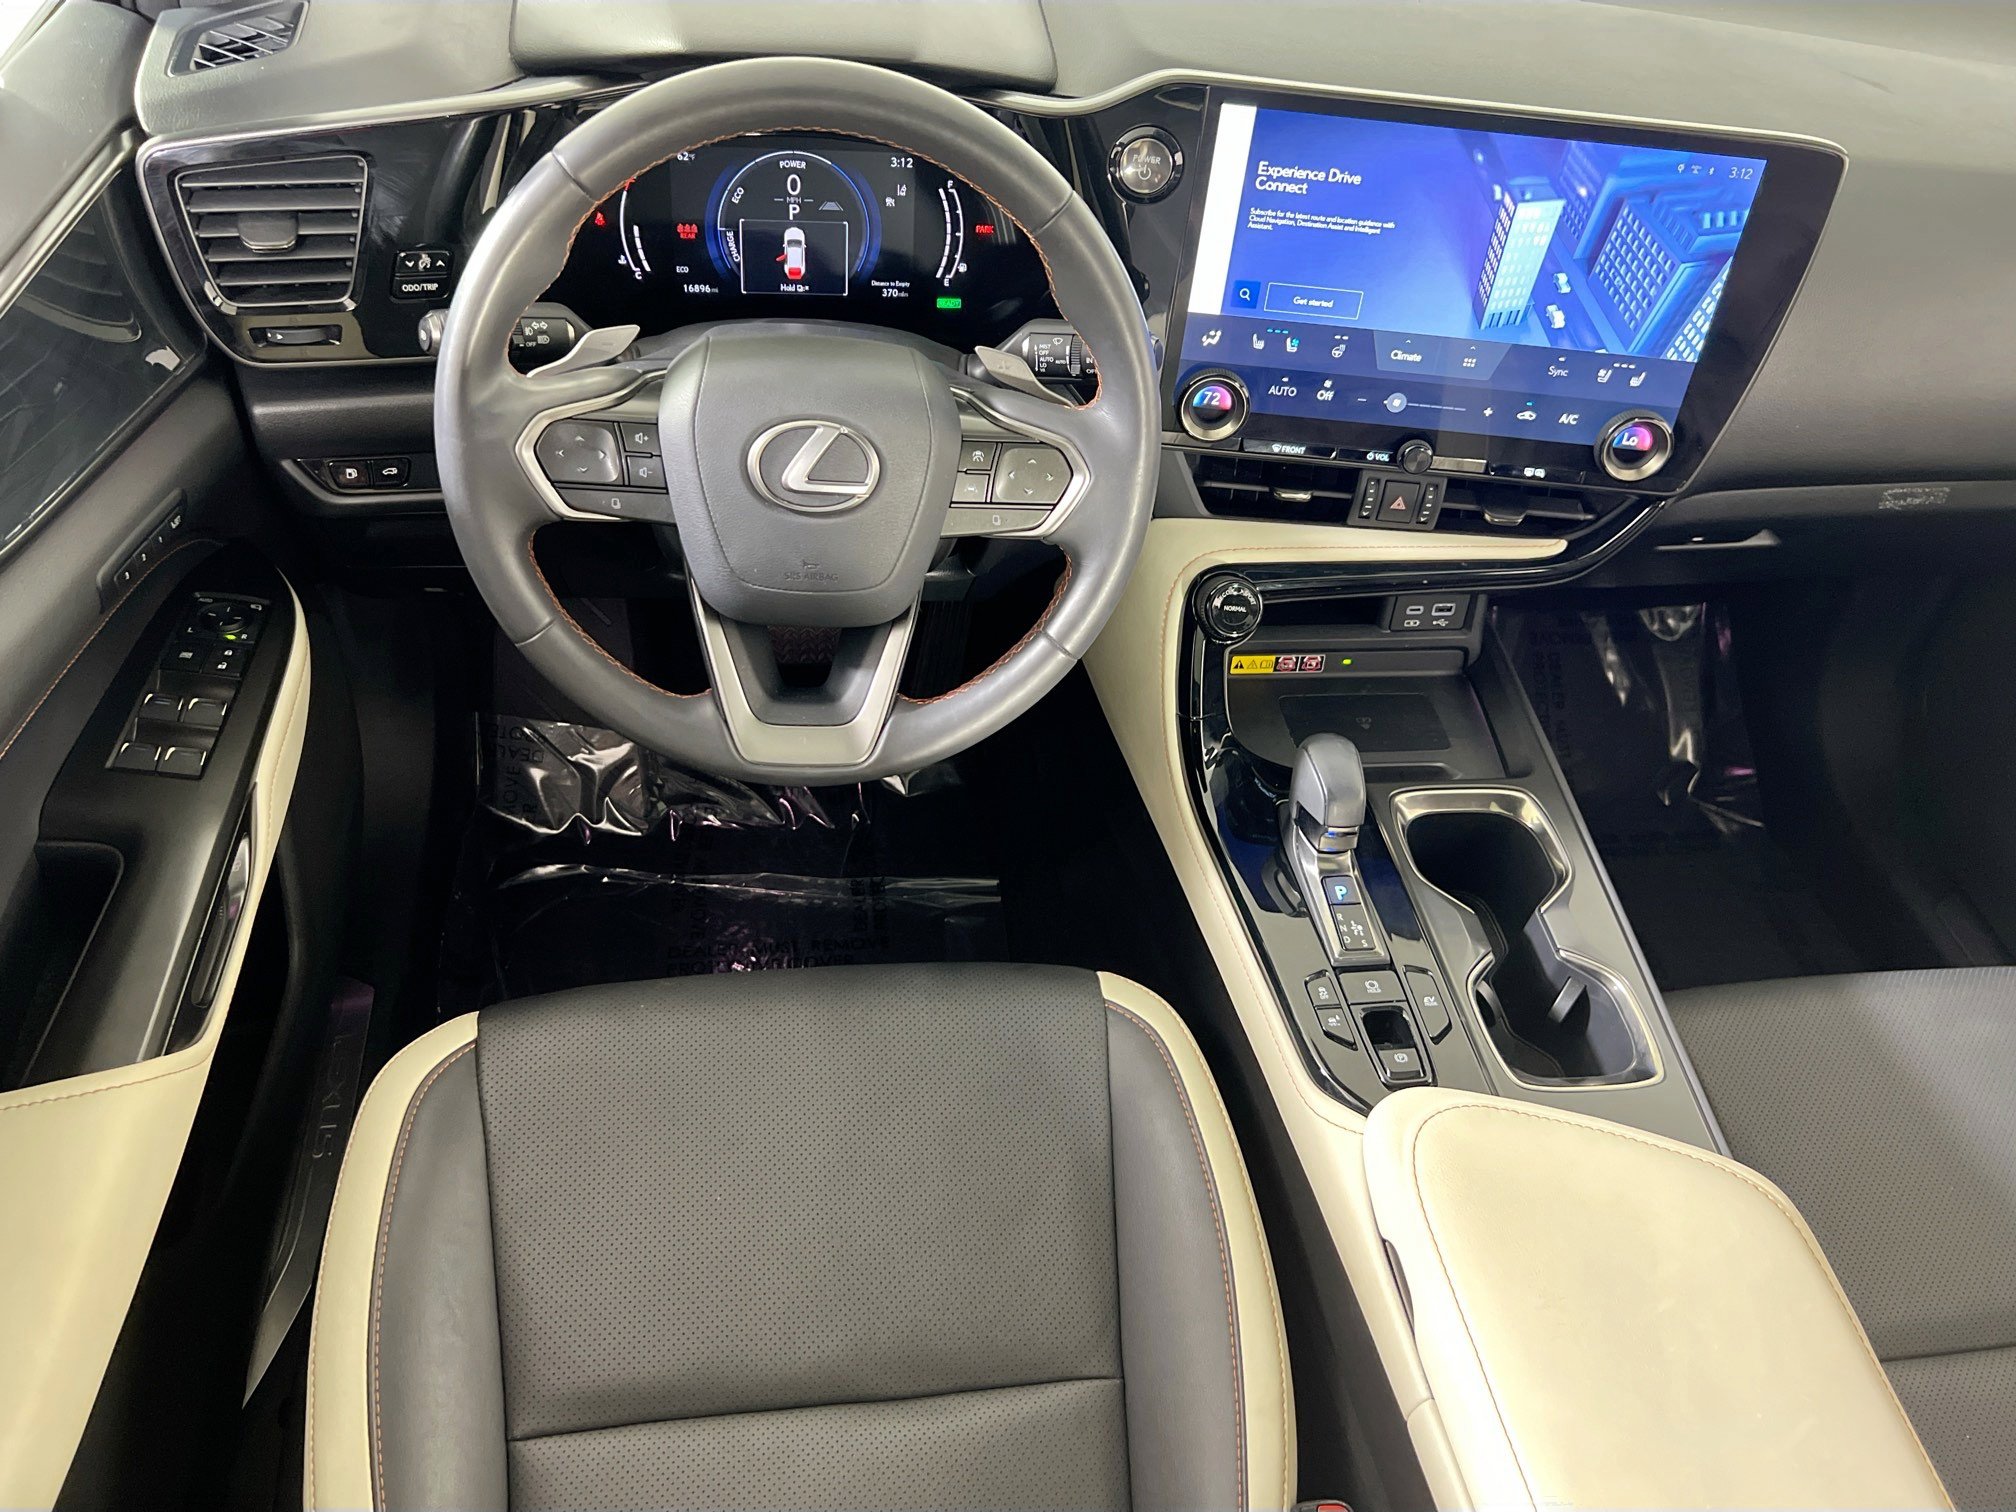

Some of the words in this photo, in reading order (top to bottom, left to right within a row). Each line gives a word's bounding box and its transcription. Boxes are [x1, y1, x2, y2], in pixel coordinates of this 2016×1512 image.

[779, 160, 806, 170] POWER
[890, 157, 914, 168] 3:12
[1132, 154, 1161, 165] POWER
[1257, 161, 1326, 181] Experience
[1328, 168, 1362, 185] Drive
[1729, 166, 1754, 180] 3:12
[947, 180, 954, 189] F
[1255, 176, 1308, 194] Connect
[732, 186, 745, 204] ECO
[788, 204, 800, 221] P
[1250, 207, 1276, 217] Subscribe
[1311, 214, 1325, 222] route
[1337, 216, 1358, 225] location
[1249, 214, 1266, 223] Cloud
[1297, 219, 1328, 229] Destination
[1327, 222, 1343, 231] Assist
[975, 225, 994, 234] PARK
[726, 230, 741, 262] CHARGE
[401, 283, 439, 292] ODO/TRIP
[683, 283, 711, 293] 16896
[780, 284, 795, 292] Hold
[882, 288, 898, 297] 370
[1293, 296, 1307, 305] Get
[1308, 299, 1334, 308] started
[1390, 349, 1422, 364] Climate
[1548, 365, 1569, 378] Sync
[1268, 385, 1298, 397] AUTO
[1316, 390, 1334, 402] Off
[1202, 391, 1221, 406] 72
[1558, 413, 1580, 425] A/C
[1621, 432, 1639, 447] Lo
[1281, 444, 1306, 455] FRONT
[1375, 453, 1390, 462] VOL
[803, 572, 839, 582] AIRBAG
[1223, 605, 1247, 613] NORMAL
[1334, 885, 1348, 901] P
[1336, 913, 1343, 922] R
[1339, 924, 1348, 932] N
[1343, 935, 1351, 944] D
